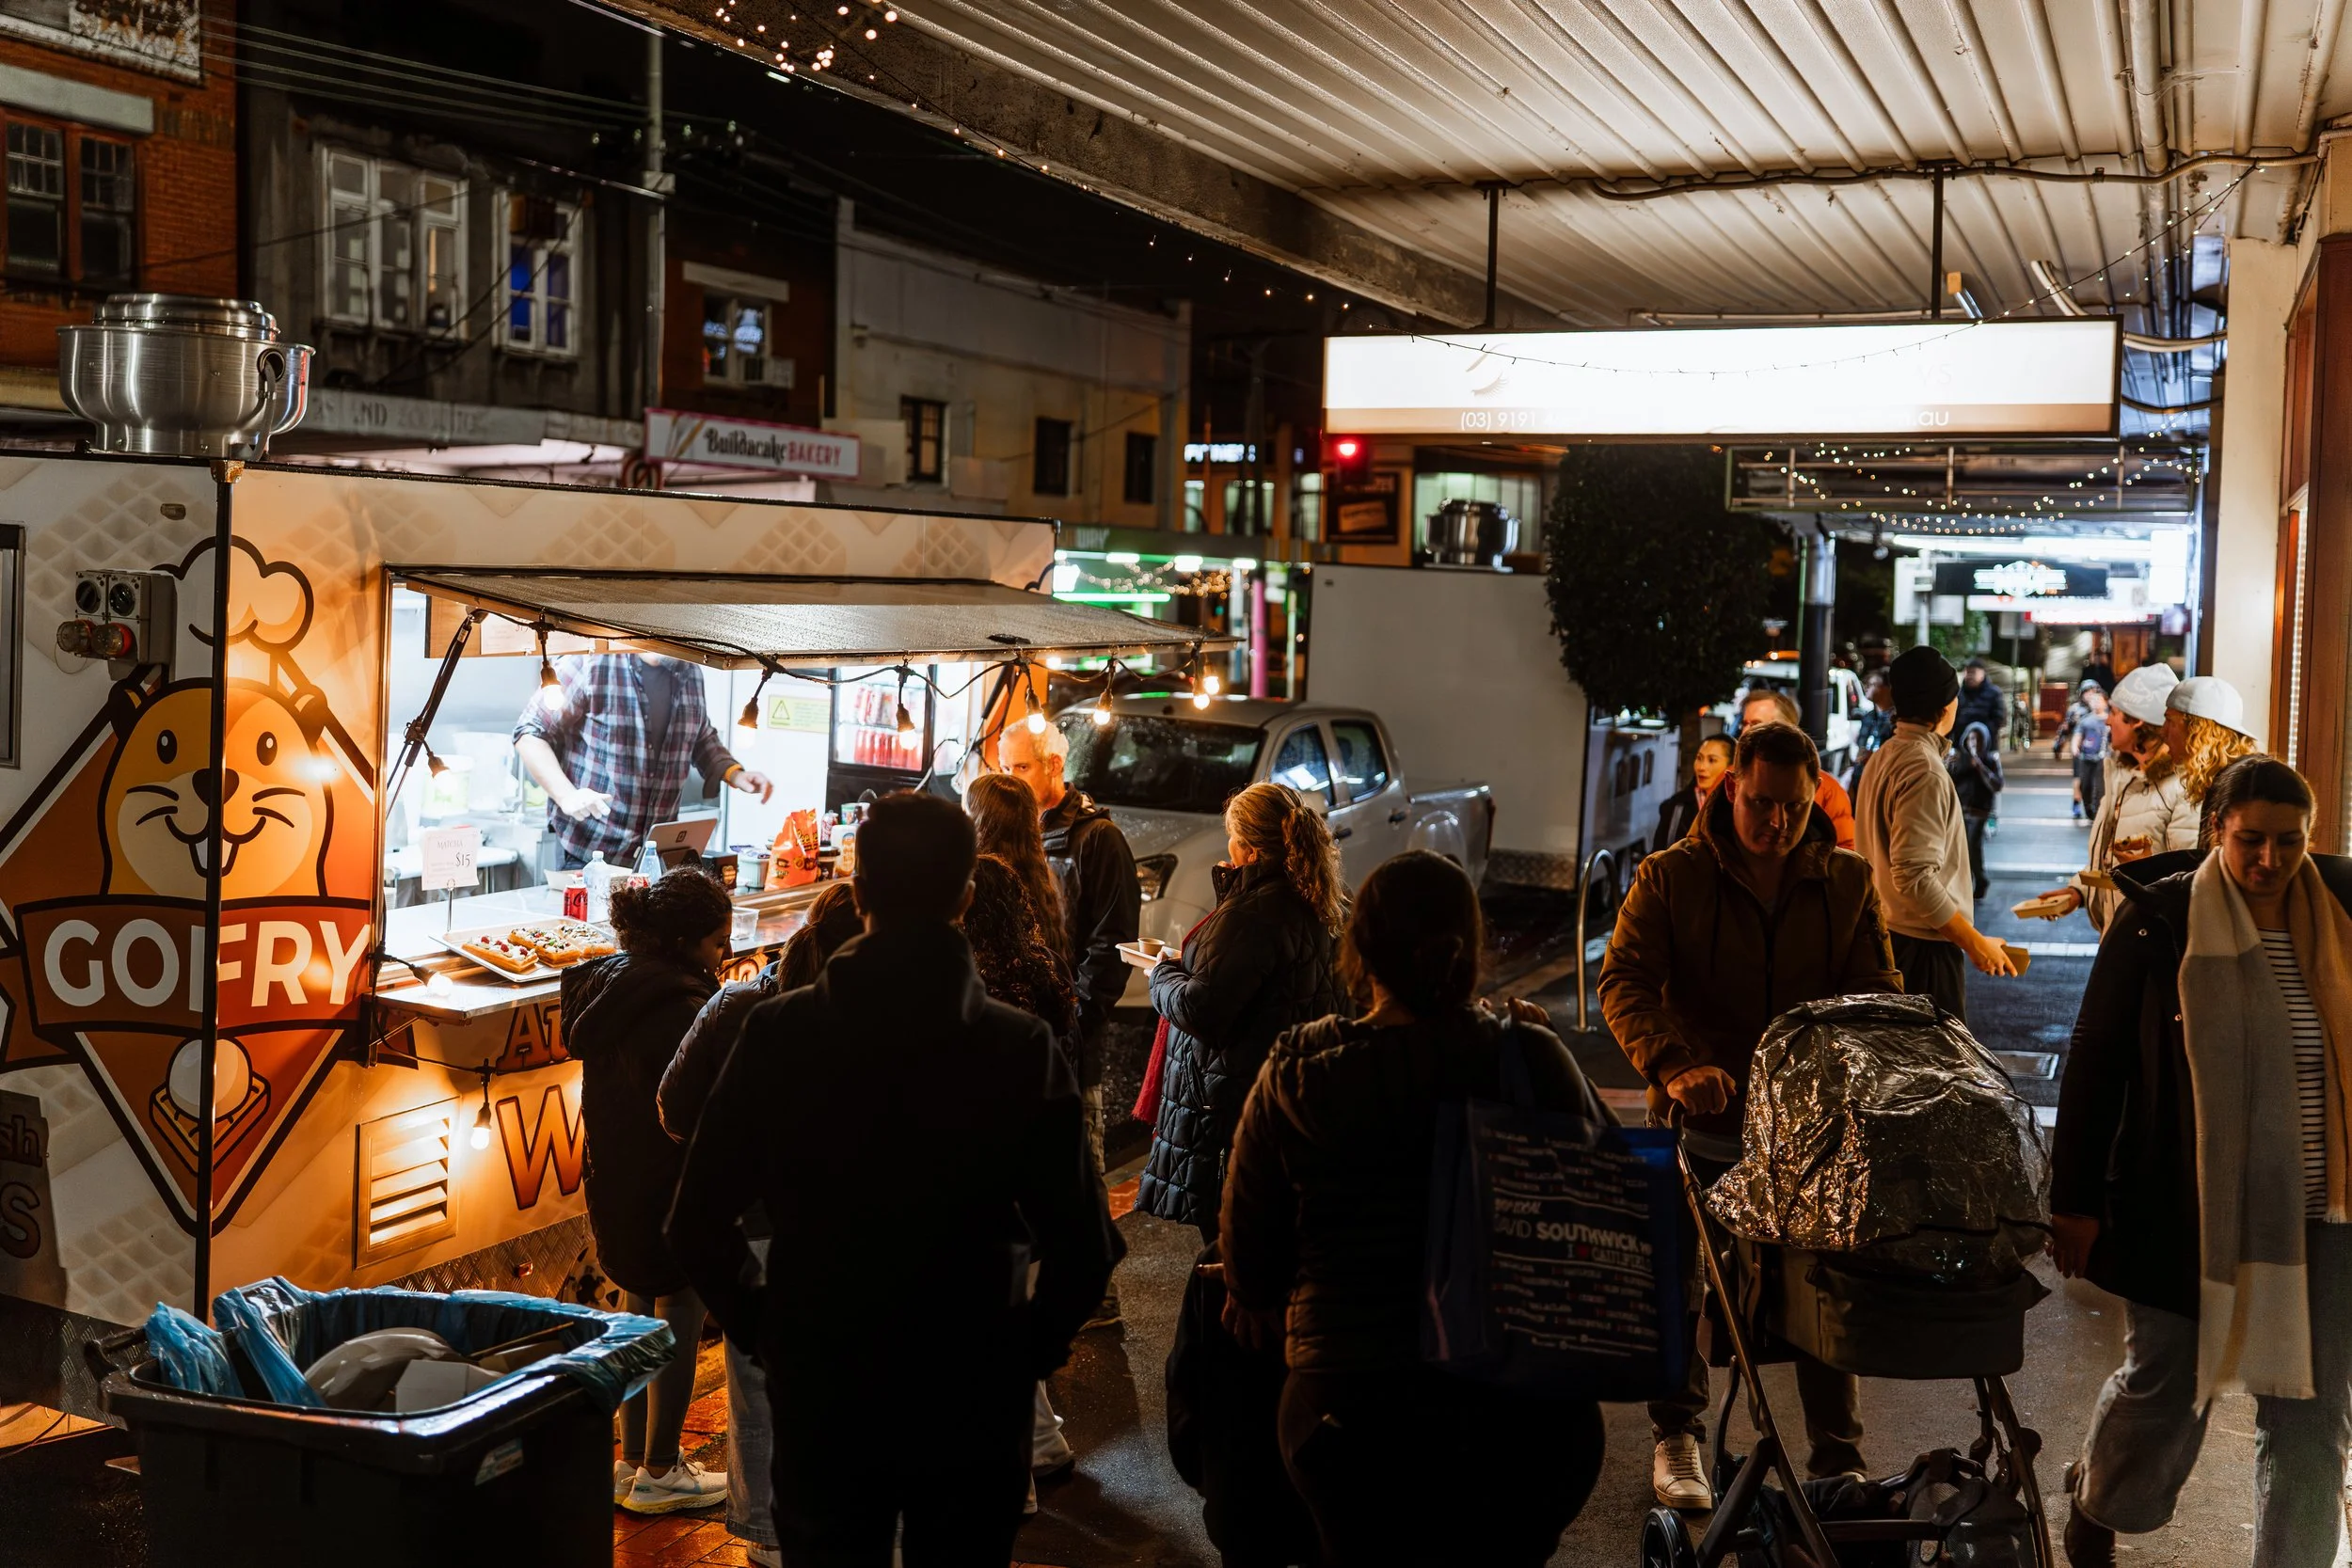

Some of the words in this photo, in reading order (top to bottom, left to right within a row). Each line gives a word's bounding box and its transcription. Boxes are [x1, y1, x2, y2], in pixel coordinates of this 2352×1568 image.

[1460, 411, 1492, 432] (03)
[1497, 411, 1536, 428] 9191
[788, 439, 842, 467] BAKERY
[455, 851, 471, 868] $15
[43, 918, 372, 1013] GOFRY
[1535, 1220, 1639, 1254] SOUTHWICK
